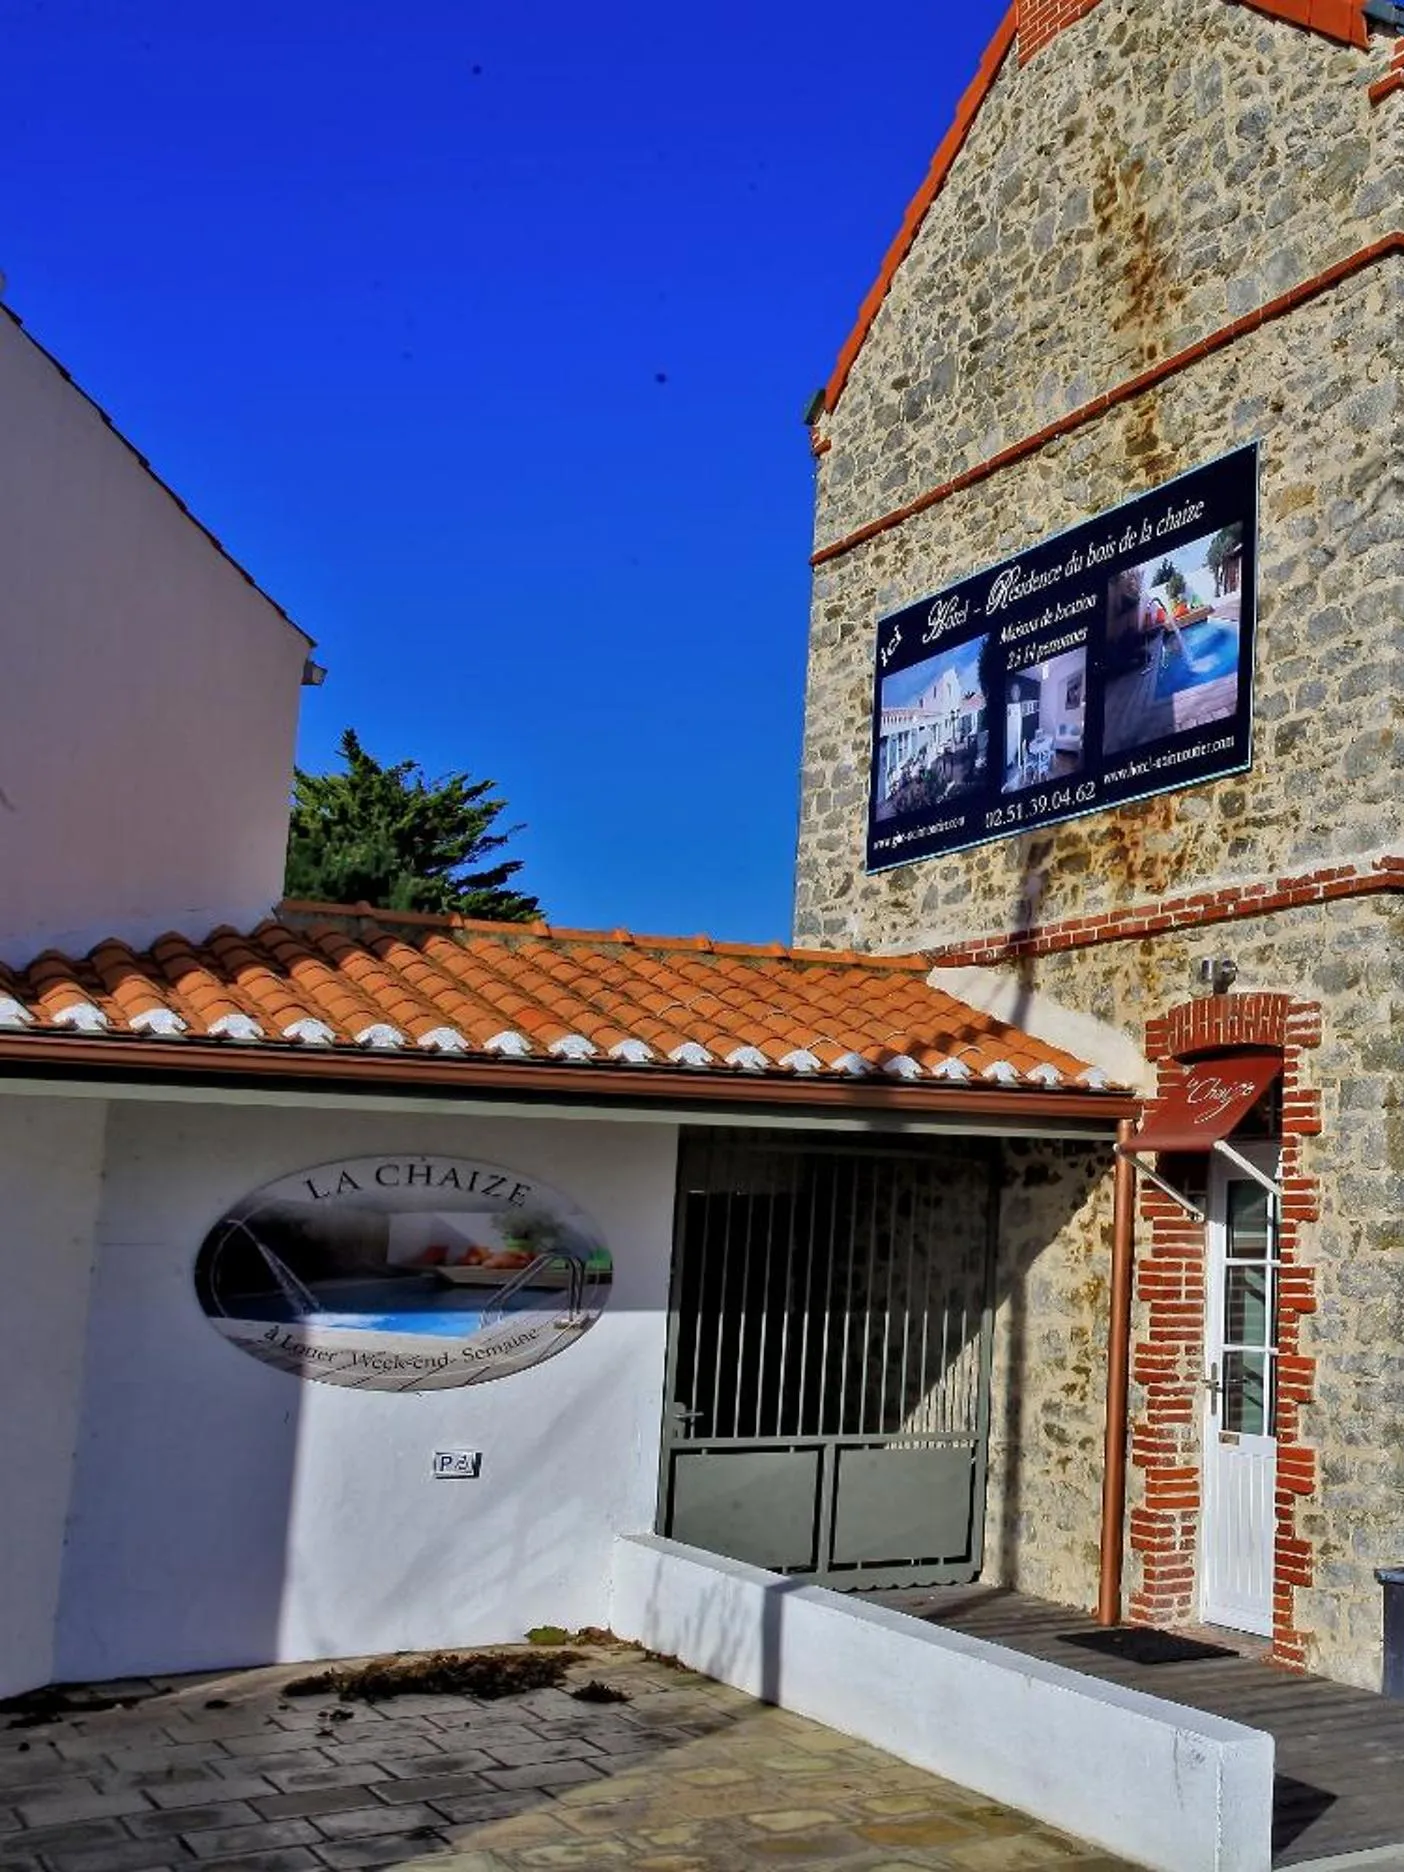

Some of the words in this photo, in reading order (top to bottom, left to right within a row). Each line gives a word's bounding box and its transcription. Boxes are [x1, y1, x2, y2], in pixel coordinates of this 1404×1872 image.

[985, 564, 1063, 615] Résidence
[1064, 549, 1083, 577] du
[1086, 534, 1117, 568] bois
[1118, 524, 1138, 554] de
[1139, 517, 1153, 545] la
[1156, 499, 1205, 537] chaize
[303, 1169, 362, 1200] LA
[375, 1163, 532, 1208] CHAIZE
[281, 1334, 339, 1363] Louer
[352, 1351, 450, 1371] Week-end
[461, 1327, 541, 1363] Semaine
[440, 1455, 453, 1471] P
